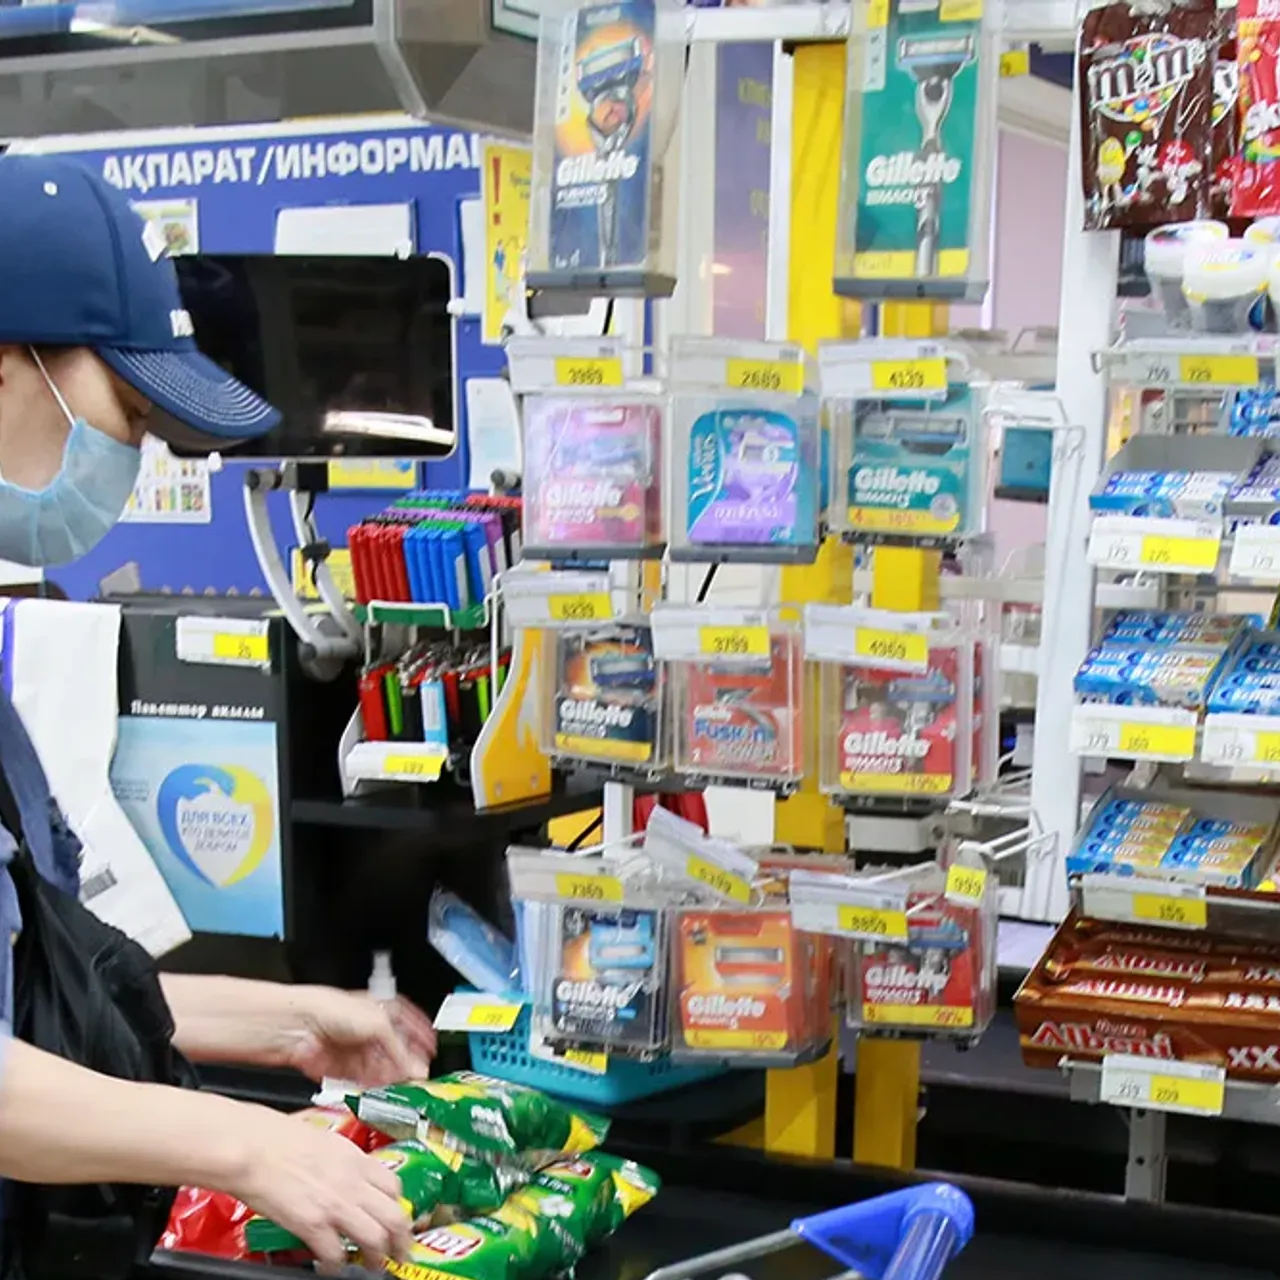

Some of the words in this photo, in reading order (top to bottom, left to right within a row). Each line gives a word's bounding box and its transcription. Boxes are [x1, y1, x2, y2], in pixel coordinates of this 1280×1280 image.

[556, 150, 640, 187] Gillette
[865, 151, 962, 188] Gillette
[854, 467, 940, 494] Gillette
[560, 698, 634, 728] Gillette
[844, 729, 932, 757] Gillette
[556, 980, 630, 1008] Gillette
[865, 966, 950, 994] Gillette
[687, 995, 766, 1017] Gillette
